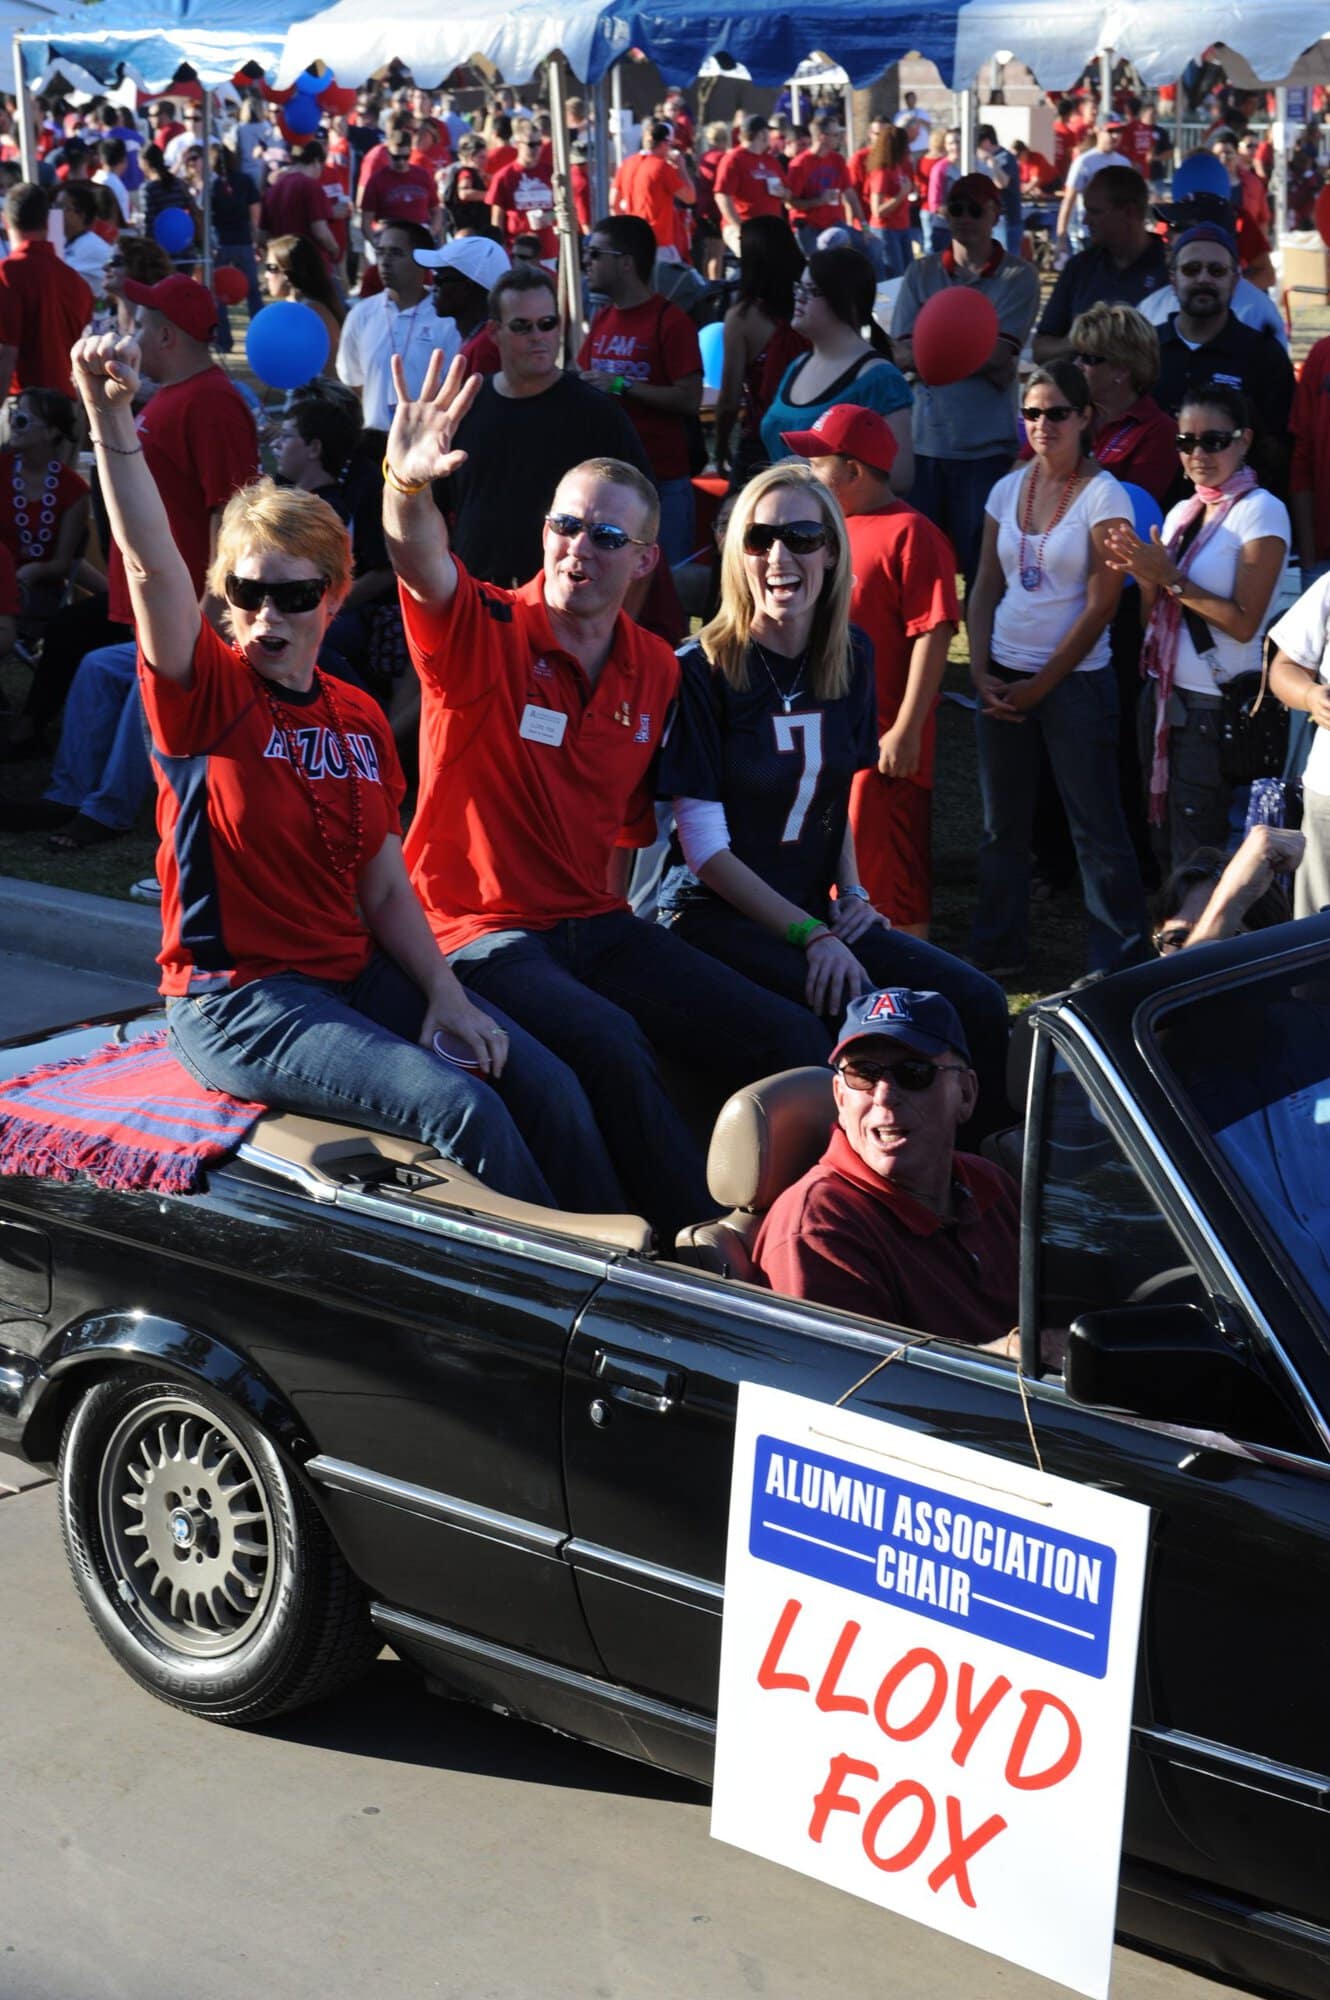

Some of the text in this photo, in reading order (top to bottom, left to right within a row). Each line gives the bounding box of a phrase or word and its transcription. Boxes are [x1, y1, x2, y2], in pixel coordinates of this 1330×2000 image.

[771, 711, 824, 844] 7
[861, 992, 912, 1024] A
[765, 1453, 1102, 1605] ALUMNI ASSOCIATION
[875, 1544, 971, 1617] CHAIR
[757, 1599, 1082, 1791] LLOYD
[808, 1752, 1008, 1908] FOX
